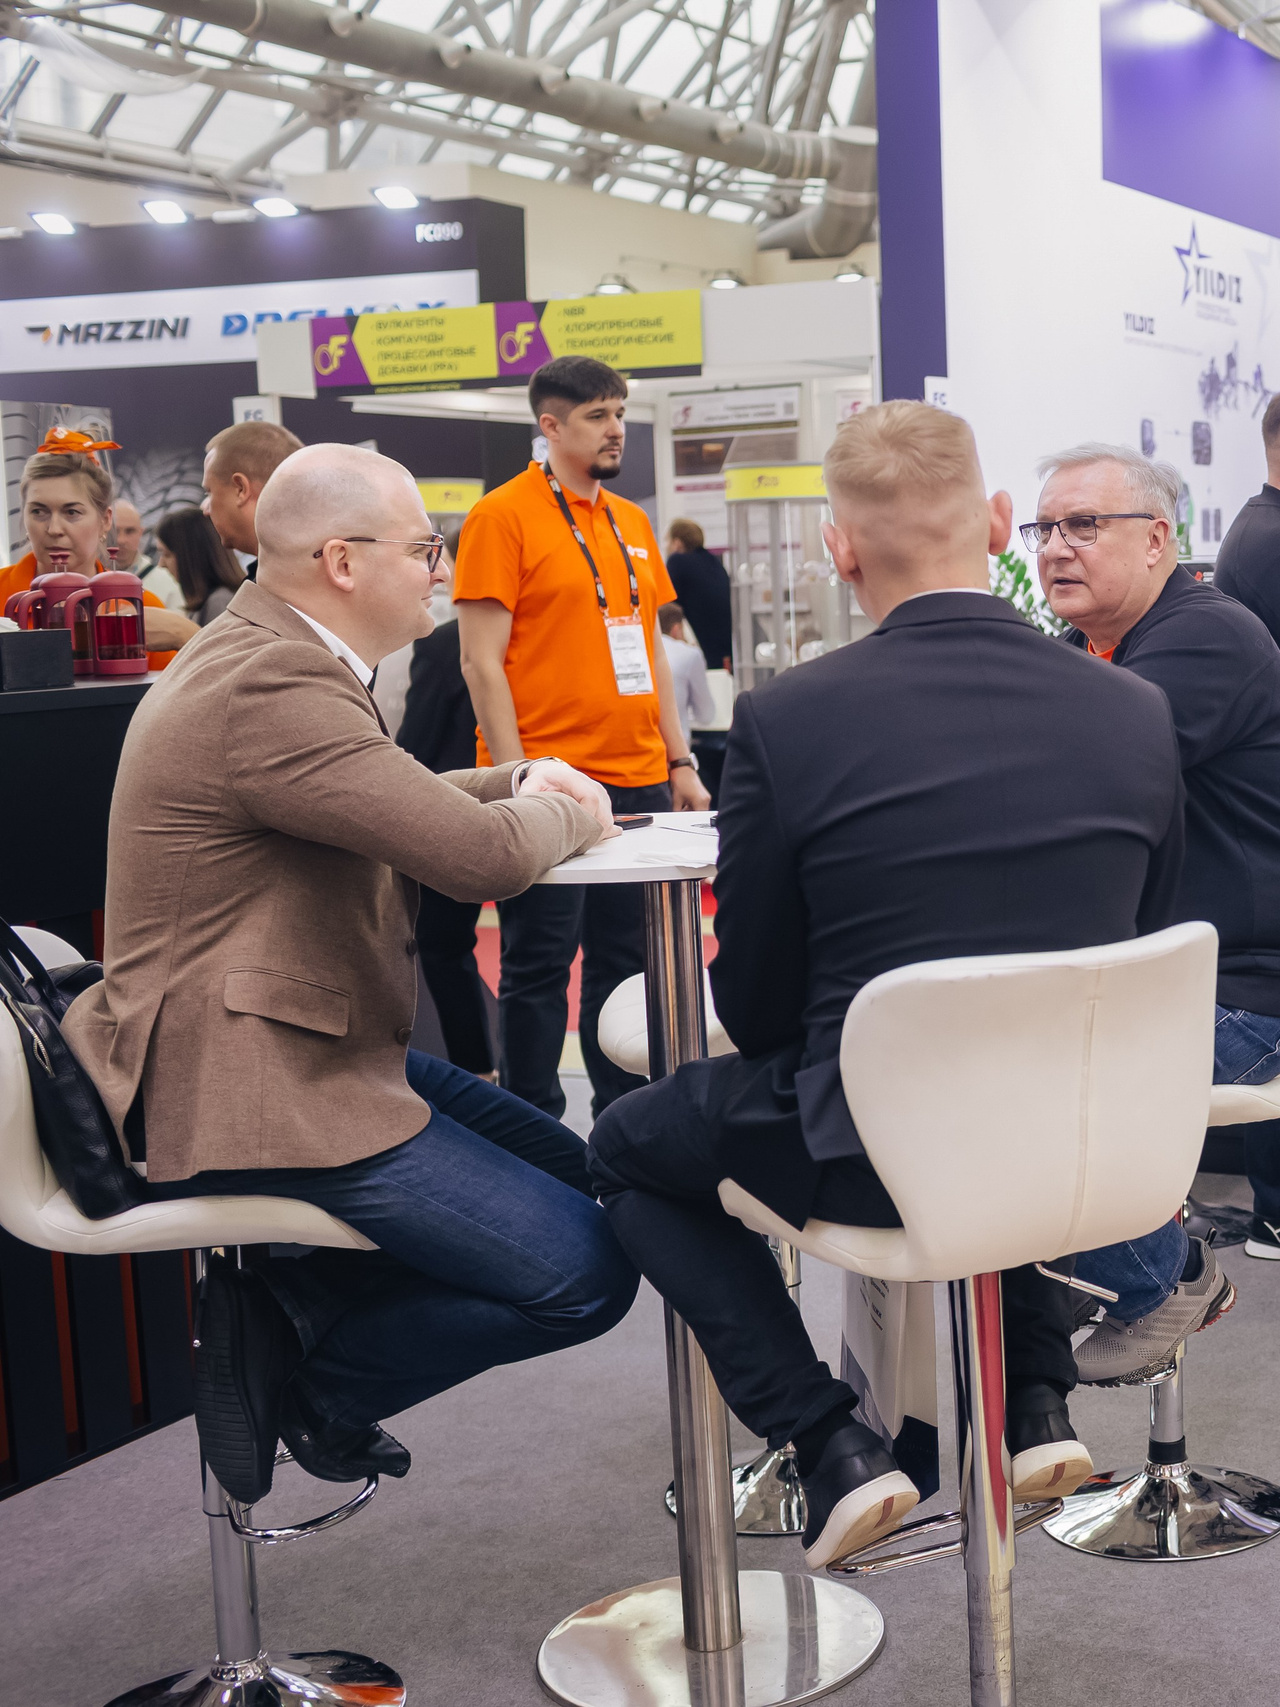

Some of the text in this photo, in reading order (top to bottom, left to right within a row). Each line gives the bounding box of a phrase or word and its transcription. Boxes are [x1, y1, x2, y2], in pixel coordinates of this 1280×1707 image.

[1195, 264, 1243, 304] YILDIZ
[57, 317, 189, 346] MAZZINI
[376, 333, 443, 347] КОМПАУНДЫ
[565, 333, 675, 349] ТЕХНОЛОГИЧЕСКИЕ
